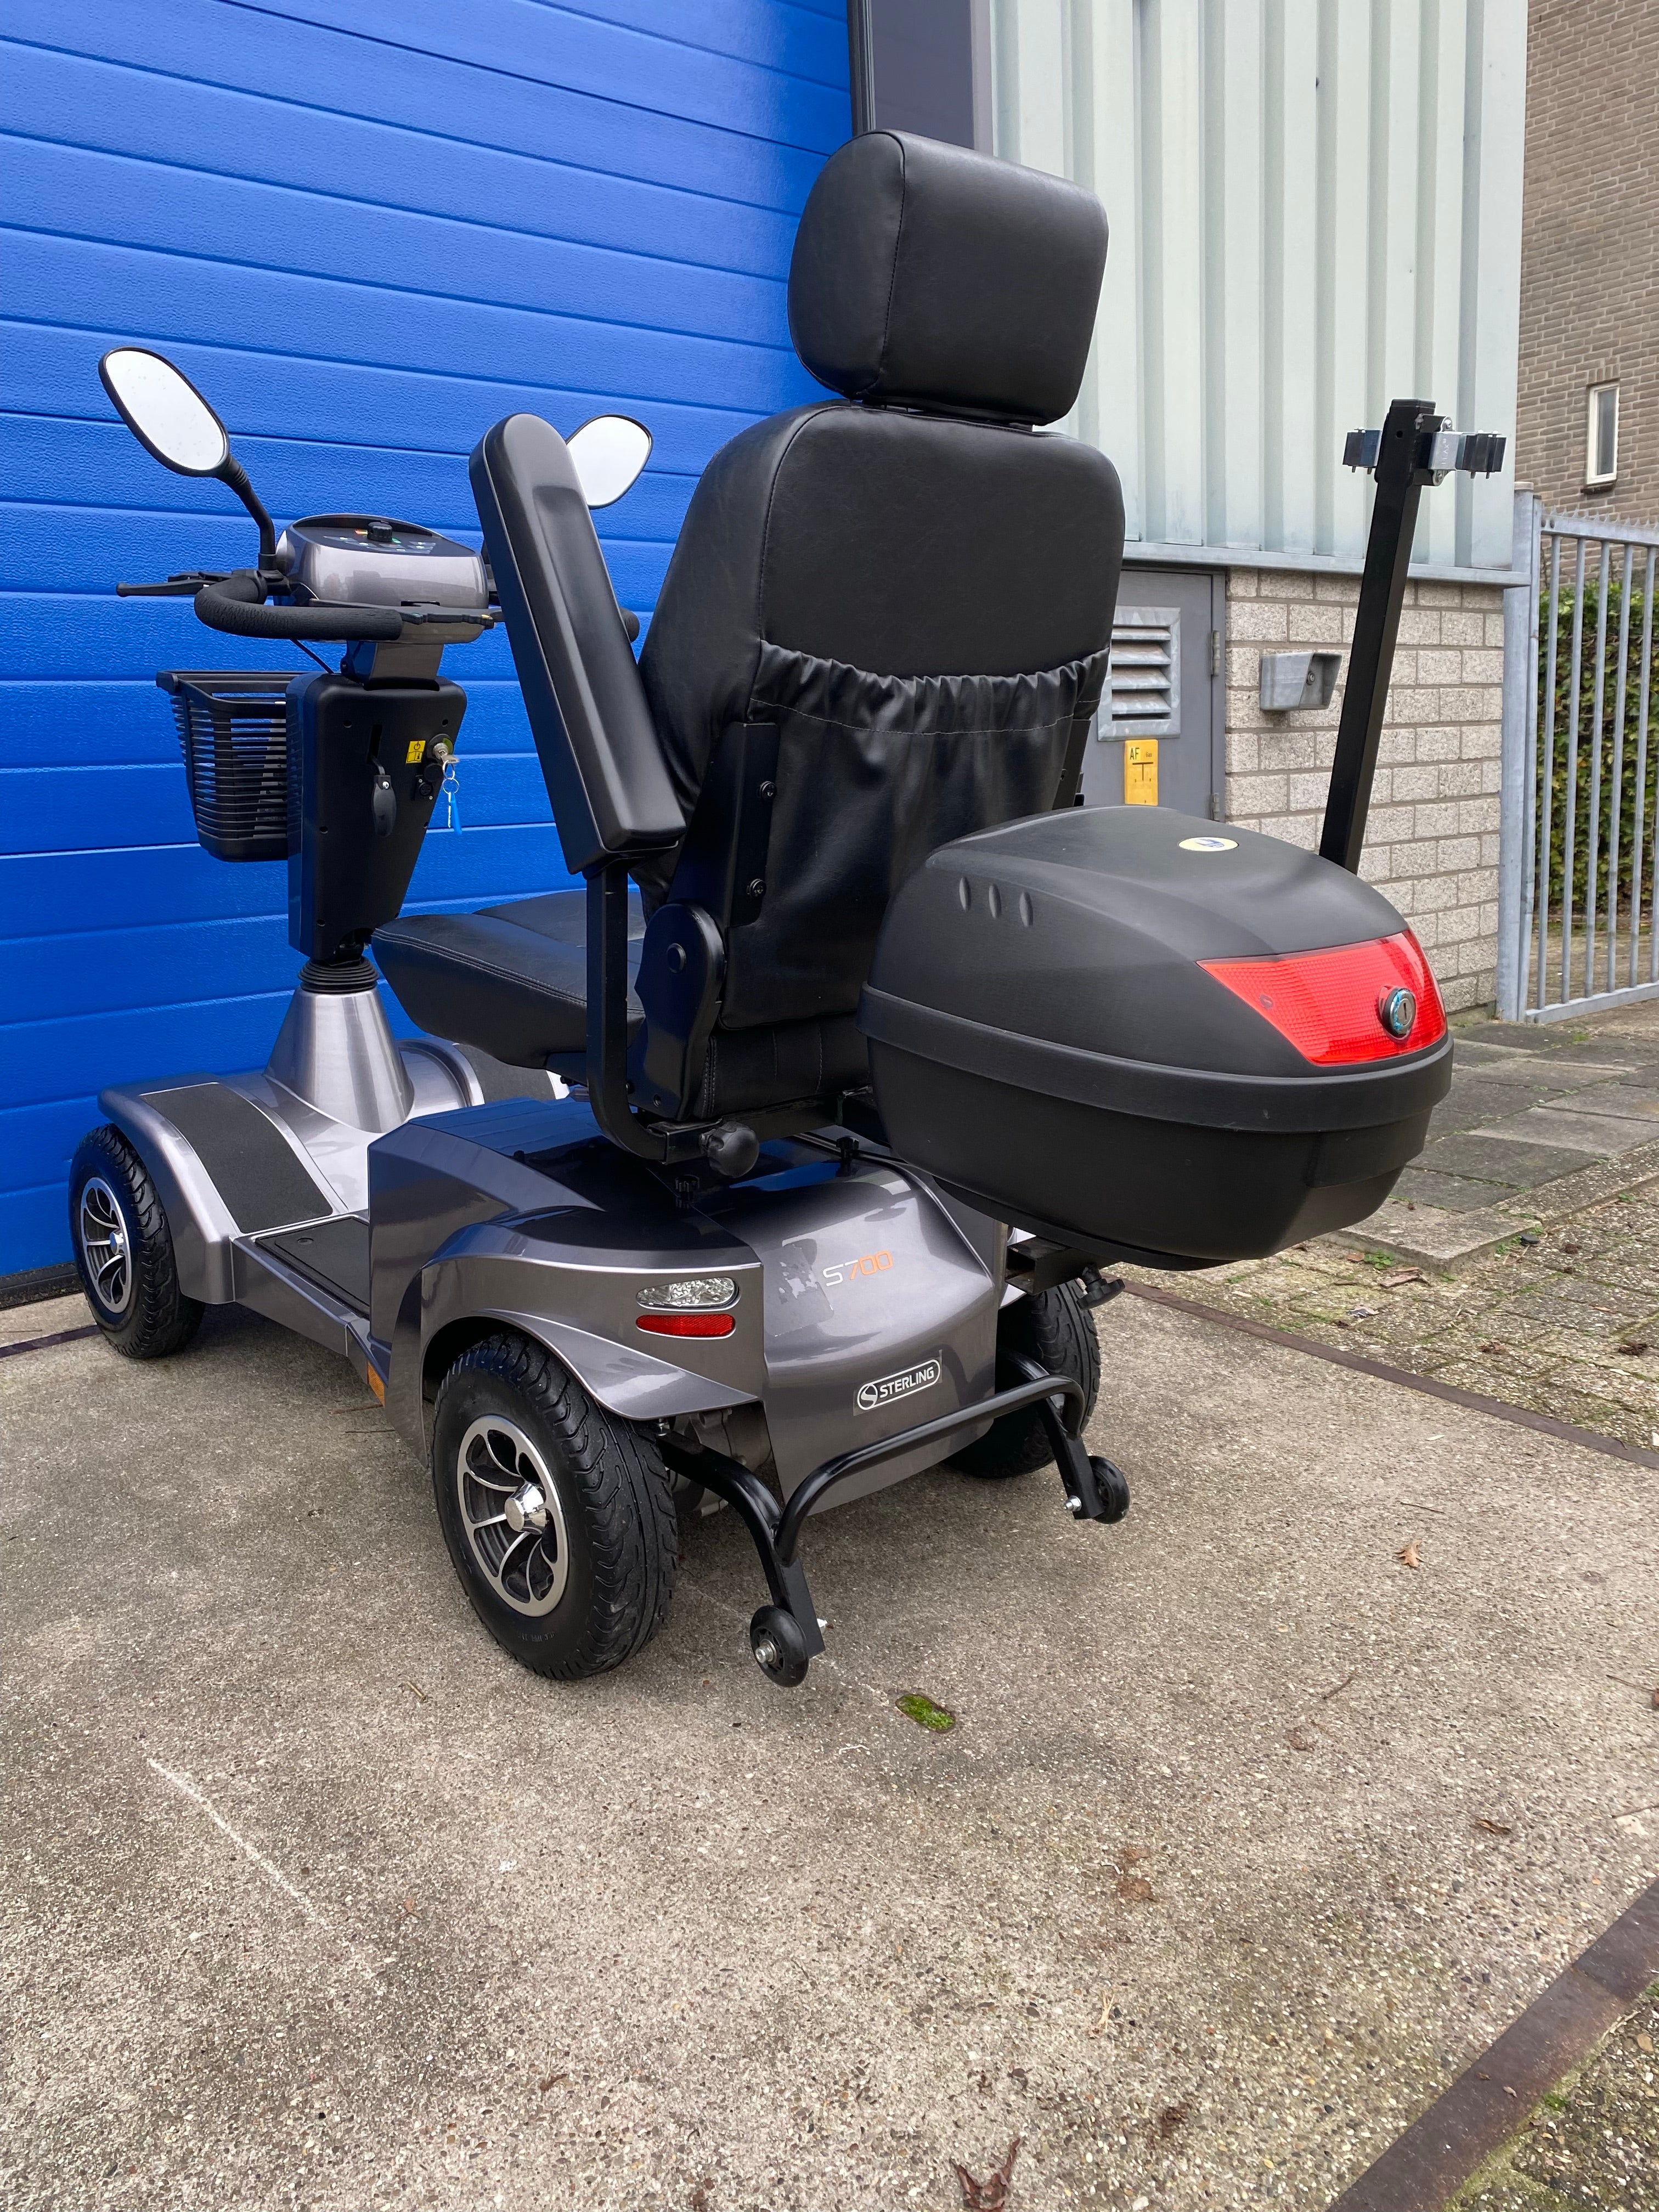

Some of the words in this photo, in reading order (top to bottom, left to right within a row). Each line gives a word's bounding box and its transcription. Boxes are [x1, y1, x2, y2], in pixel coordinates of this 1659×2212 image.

[1130, 747, 1139, 760] AF
[823, 1250, 893, 1286] S700
[879, 1366, 934, 1398] STERLING
